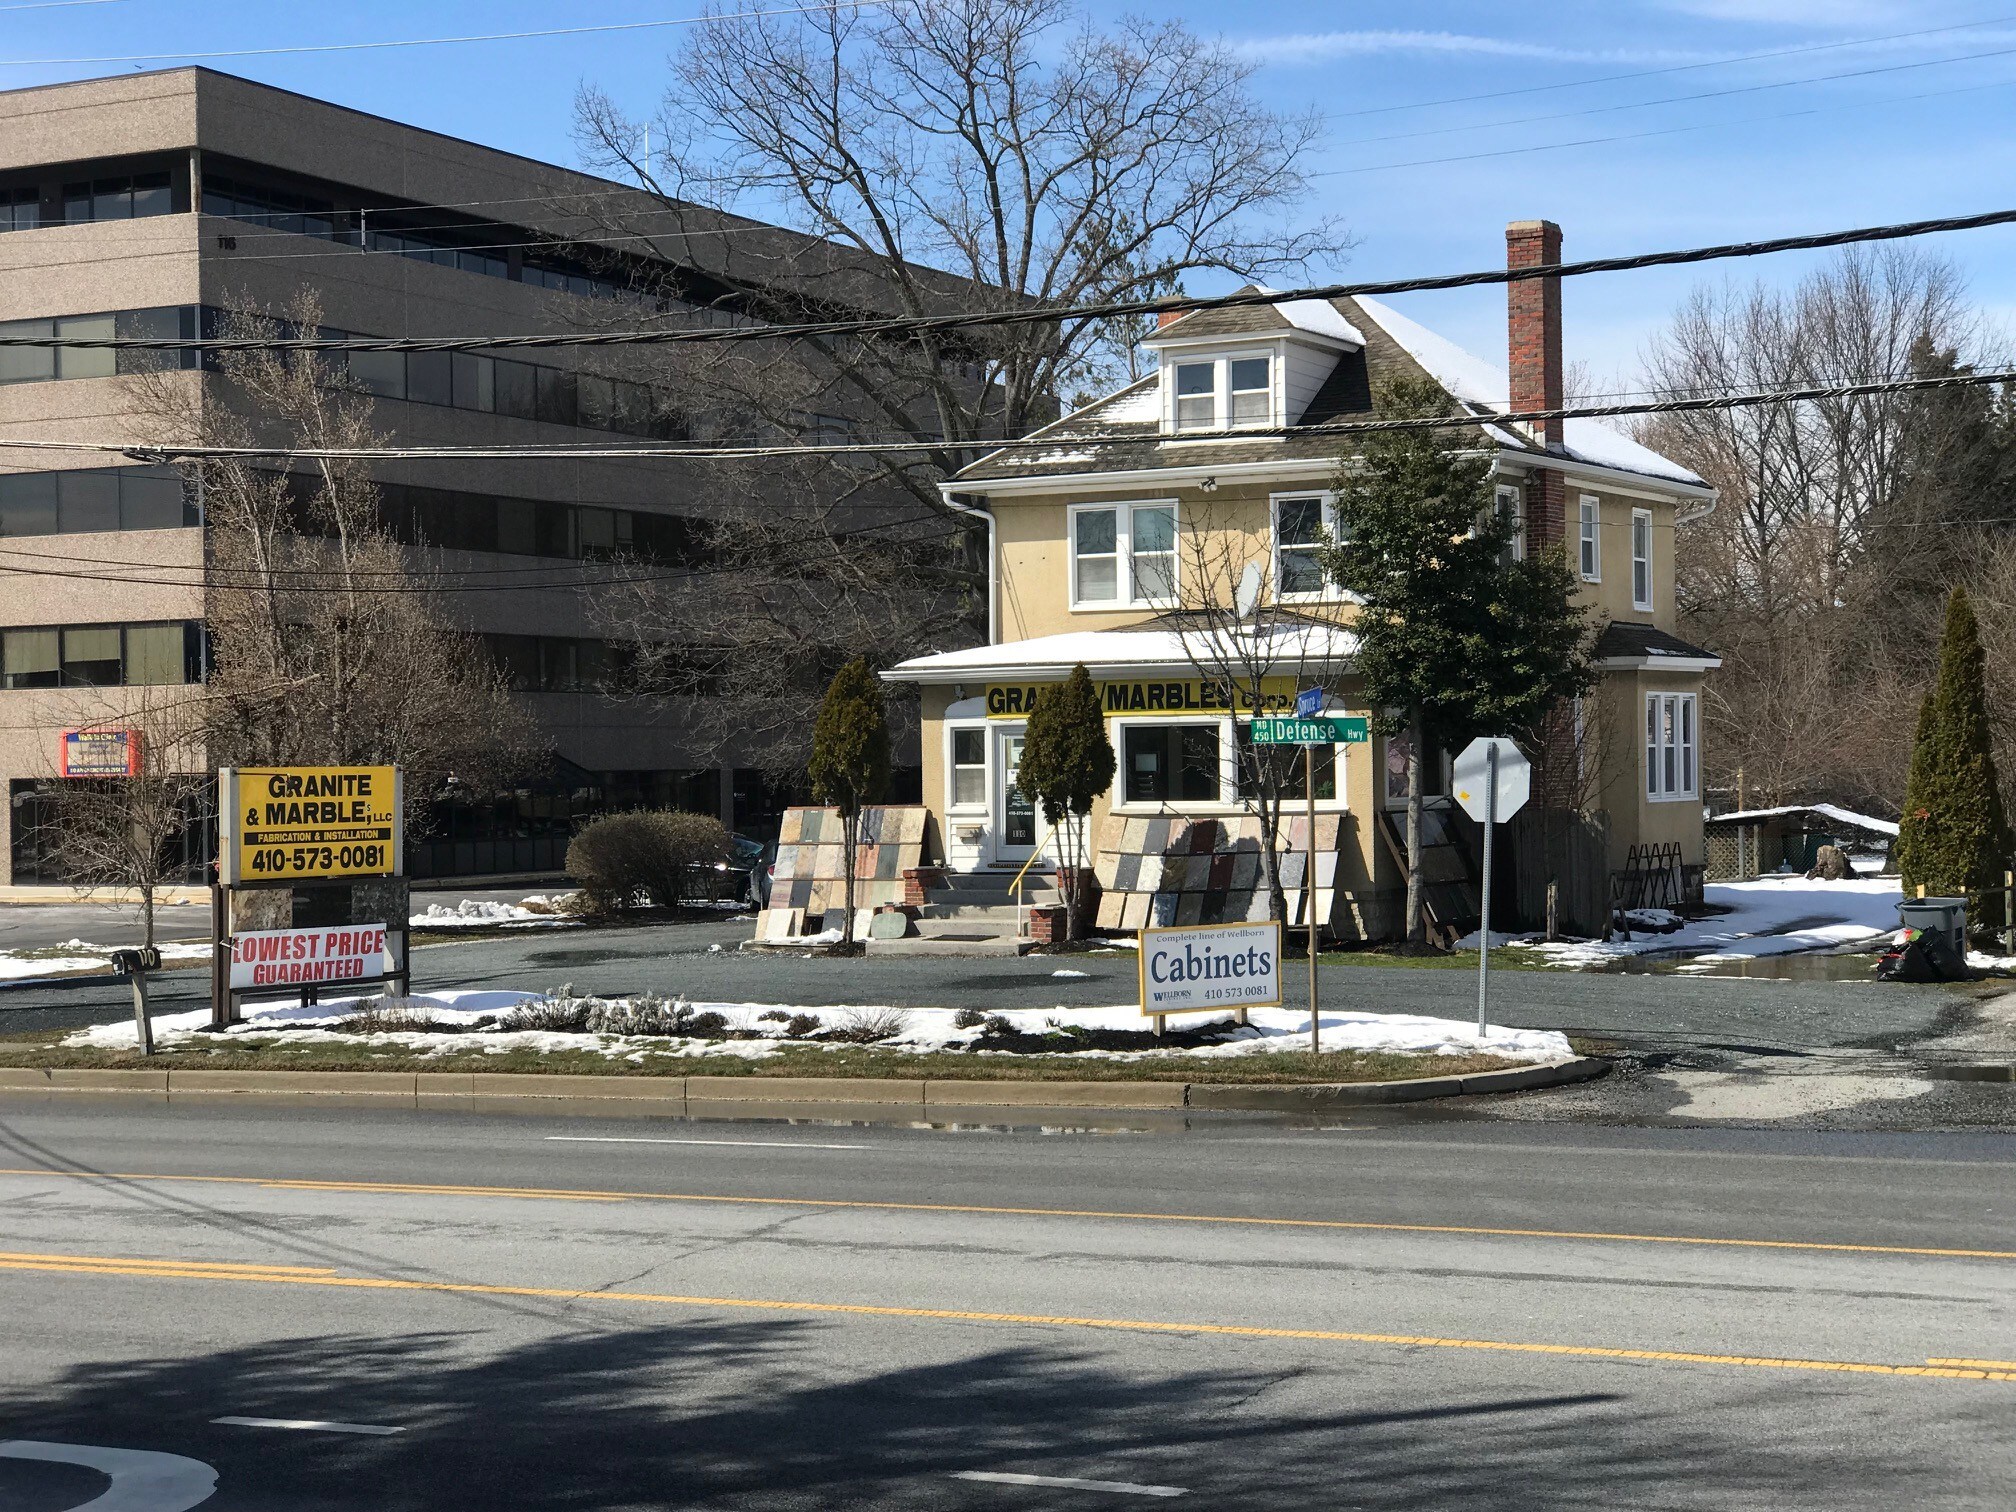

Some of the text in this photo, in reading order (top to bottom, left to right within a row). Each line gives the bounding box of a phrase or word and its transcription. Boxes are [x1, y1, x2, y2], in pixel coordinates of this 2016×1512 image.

[1256, 720, 1267, 730] MD
[1277, 722, 1363, 741] Defense Hwy
[1254, 731, 1269, 741] 450
[268, 774, 371, 798] GRANITE
[246, 808, 259, 826] &
[374, 813, 392, 821] LLC
[258, 830, 378, 843] FABRICATION & INSTALLATION
[252, 845, 384, 872] 410-573-0081
[1156, 929, 1265, 943] Complete line of Wellborn
[233, 930, 384, 963] LOWEST PRICE
[138, 949, 155, 967] 110
[1151, 943, 1271, 983] Cabinets
[253, 958, 364, 985] GUARANTEED
[1205, 989, 1222, 1000] 410
[1225, 988, 1242, 998] 573
[1245, 986, 1267, 997] 0081
